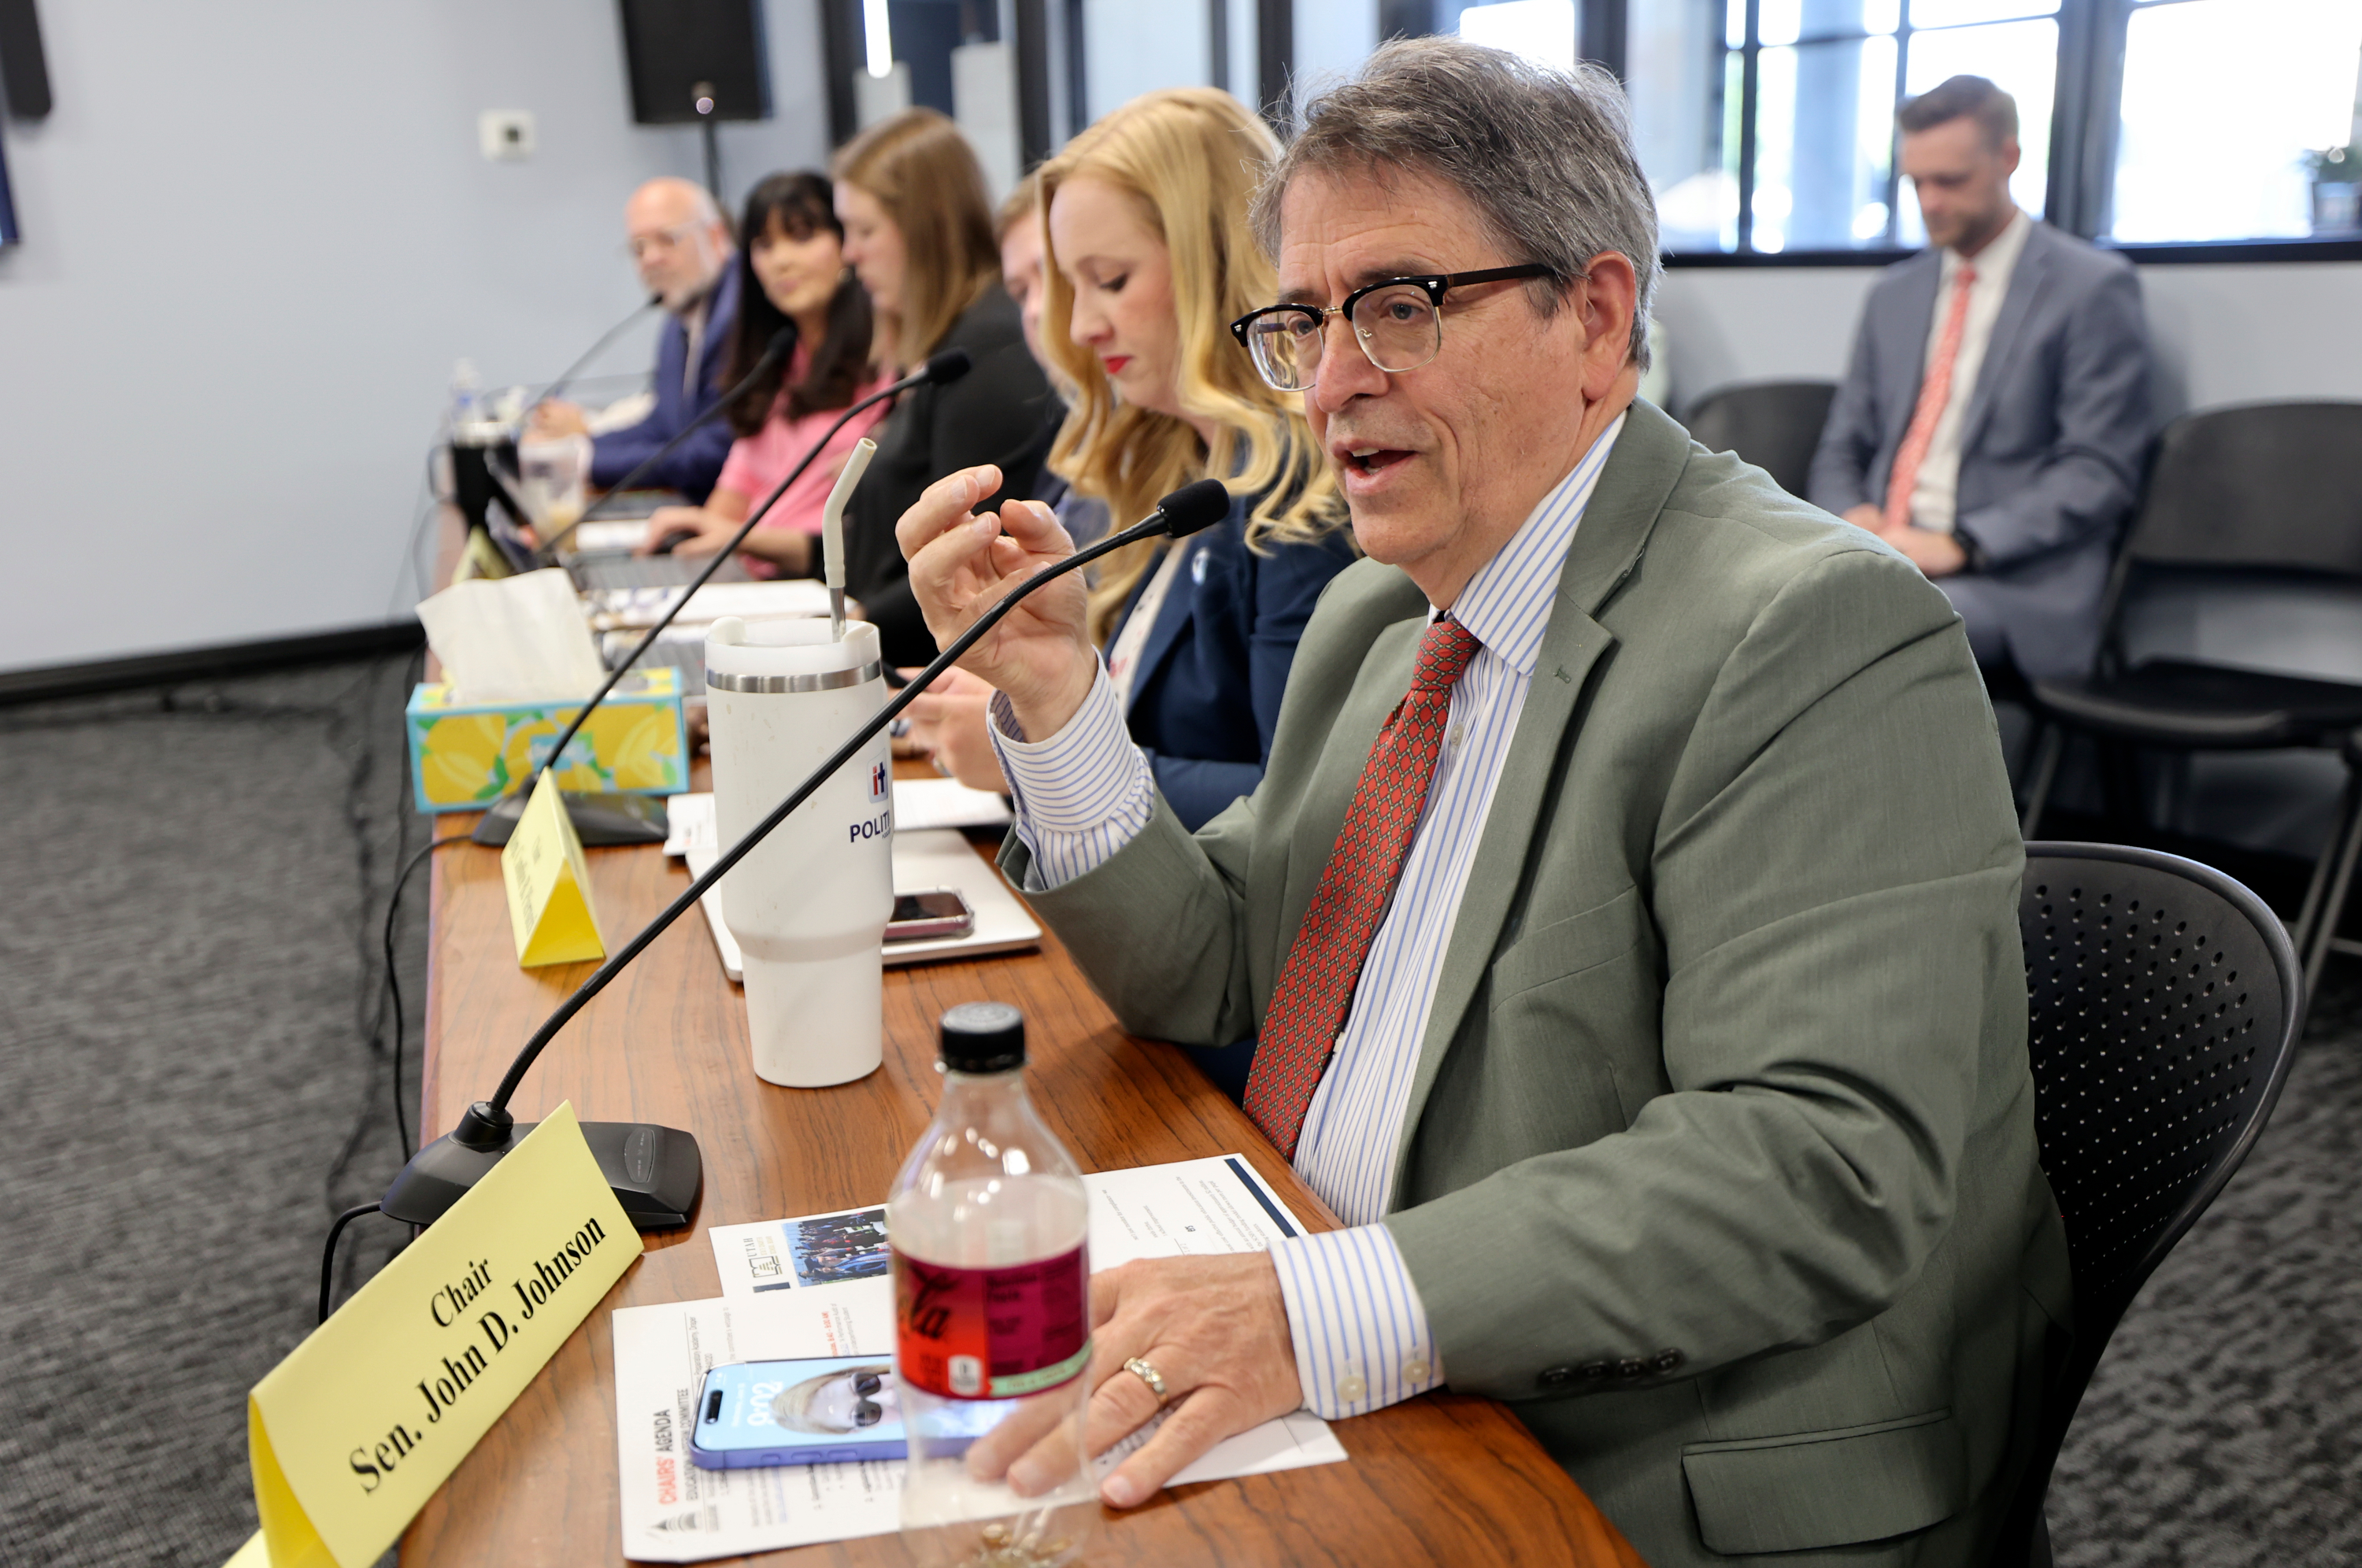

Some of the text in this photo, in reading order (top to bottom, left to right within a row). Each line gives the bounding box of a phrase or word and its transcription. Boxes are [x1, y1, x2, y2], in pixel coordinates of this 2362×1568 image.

[872, 761, 886, 796] it
[743, 1237, 757, 1257] UTAH
[430, 1258, 494, 1328] Chair
[348, 1215, 606, 1496] Sen. John D. Johnson
[746, 1380, 784, 1426] 9:02
[653, 1409, 672, 1452] AGENDA
